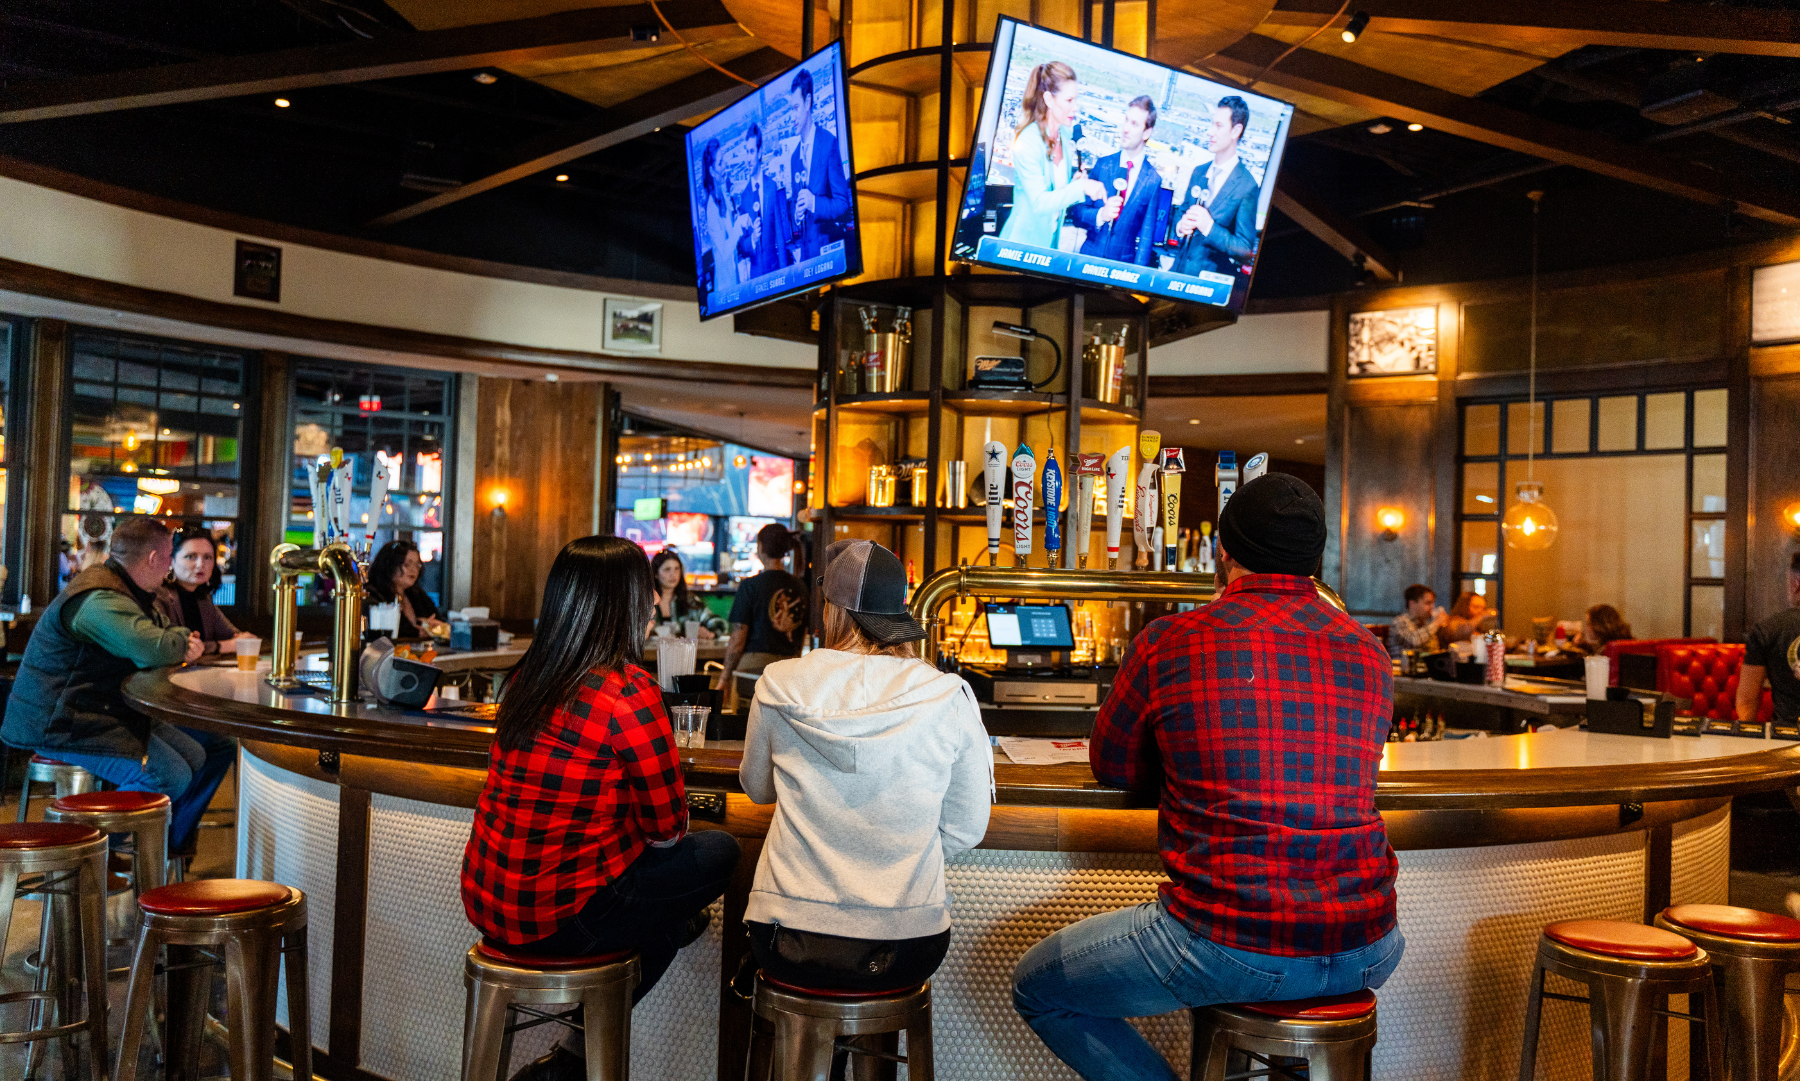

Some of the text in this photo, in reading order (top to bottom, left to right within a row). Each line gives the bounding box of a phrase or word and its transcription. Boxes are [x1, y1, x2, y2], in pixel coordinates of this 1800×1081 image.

[997, 248, 1052, 267] JAMIE LITTLE
[803, 260, 834, 278] JOEY LOGANO
[1082, 264, 1109, 278] DANIEL
[755, 281, 769, 293] DANIEL
[1167, 280, 1214, 297] JOEY LOGANO
[988, 483, 1001, 506] Lite
[1046, 468, 1056, 529] KEYSTONE LIGHT
[1014, 480, 1033, 544] Coors
[1167, 493, 1178, 527] Coors
